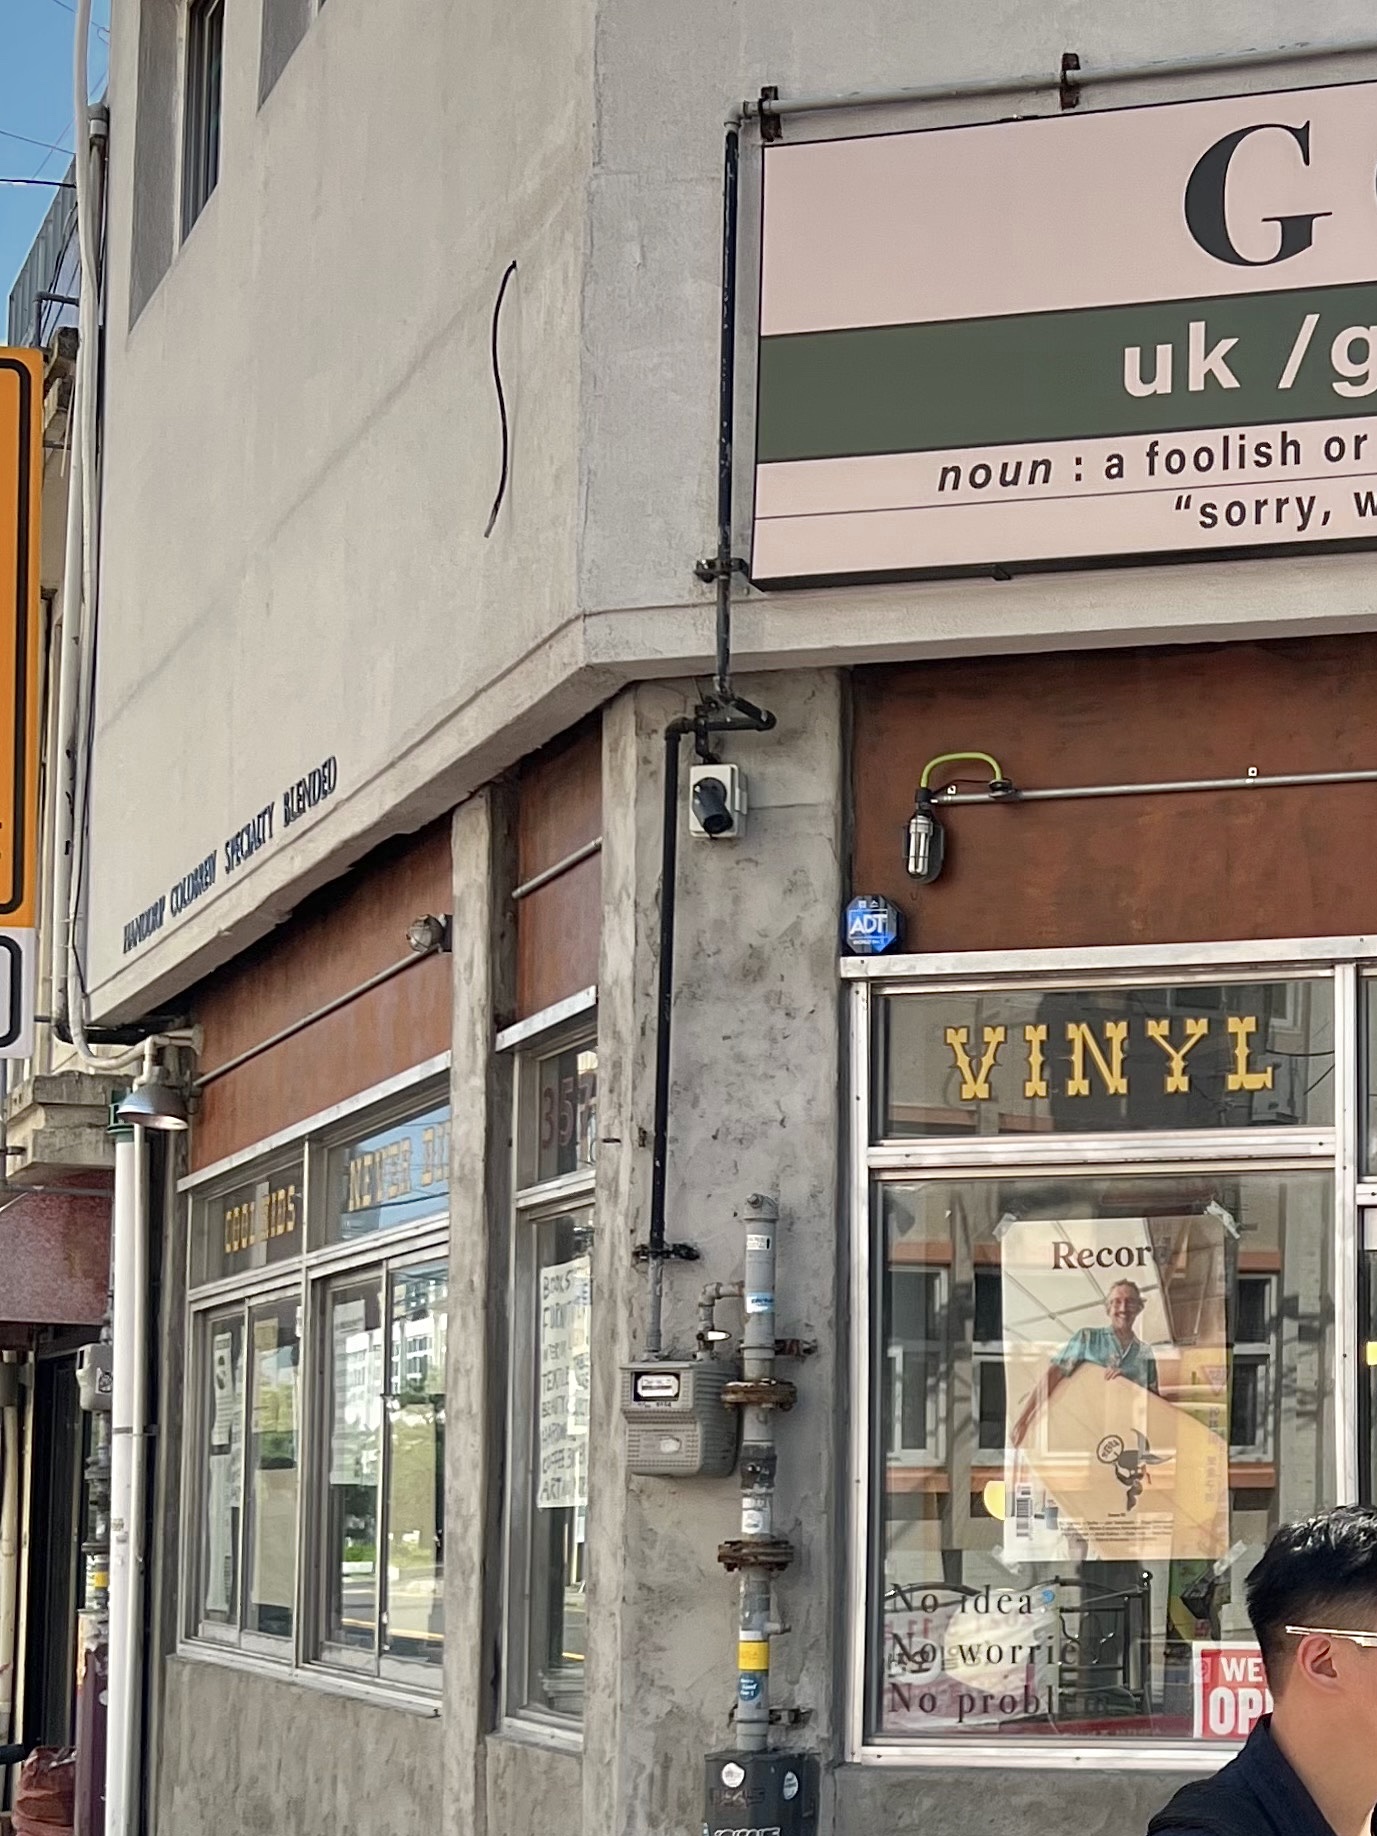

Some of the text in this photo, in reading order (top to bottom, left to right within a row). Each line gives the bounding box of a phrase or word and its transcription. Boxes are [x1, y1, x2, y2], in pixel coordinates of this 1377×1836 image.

[1123, 320, 1242, 398] uk
[937, 458, 1053, 492] noun
[1104, 453, 1125, 480] a
[1145, 430, 1302, 477] foolish
[1324, 433, 1369, 463] or
[224, 801, 275, 875] SPECIALTY
[282, 755, 338, 828] BLENDED
[849, 913, 888, 935] ADT
[944, 1014, 1274, 1101] VINYL
[888, 1582, 1033, 1615] No idea
[889, 1631, 1079, 1666] No worrie
[887, 1682, 938, 1714] No
[1208, 1685, 1275, 1736] OP
